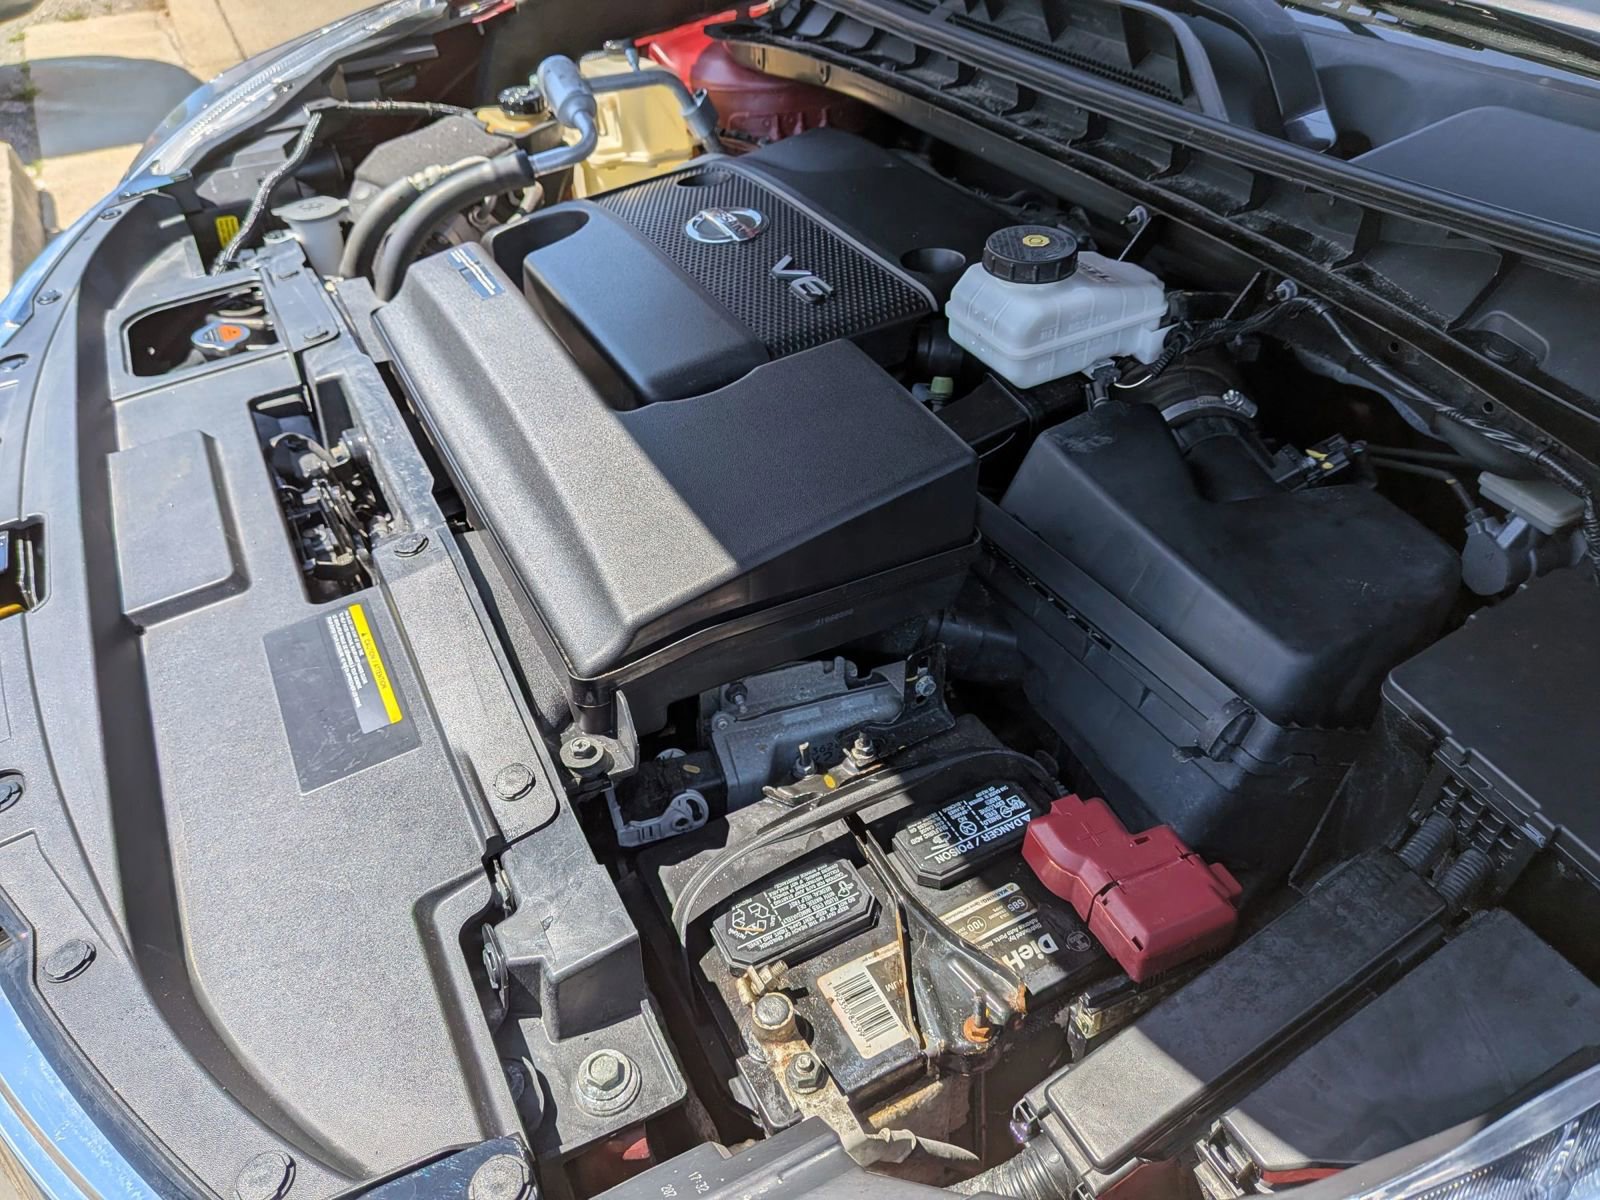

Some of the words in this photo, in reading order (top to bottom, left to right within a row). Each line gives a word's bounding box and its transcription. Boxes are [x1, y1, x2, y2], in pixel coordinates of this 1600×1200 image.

[771, 254, 833, 303] V6
[980, 817, 1023, 842] DANGER
[934, 839, 974, 864] POISON
[966, 917, 984, 933] 100
[1005, 926, 1019, 937] Auto
[1015, 921, 1042, 939] Distributed
[1017, 916, 1038, 931] Advance
